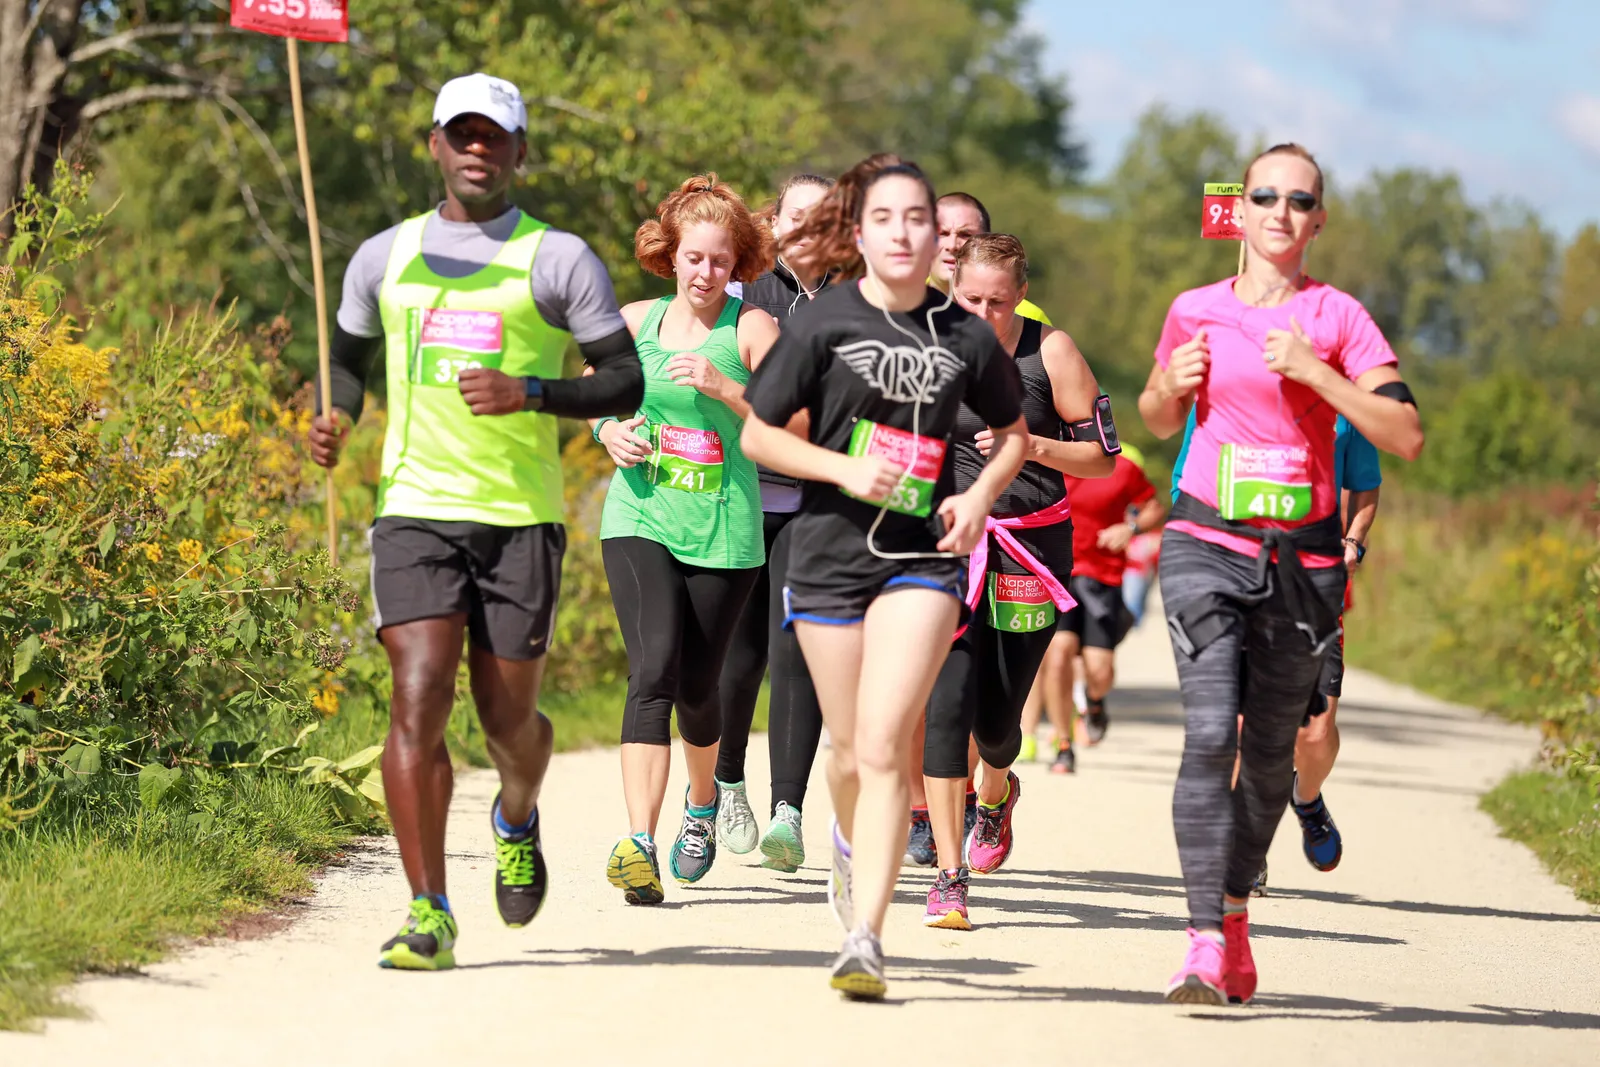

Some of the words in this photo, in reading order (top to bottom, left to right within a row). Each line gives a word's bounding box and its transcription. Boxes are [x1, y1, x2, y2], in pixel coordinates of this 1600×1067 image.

[663, 427, 721, 445] Naperville
[662, 438, 686, 452] Trails
[686, 447, 720, 456] Marathon
[1236, 445, 1308, 462] Naperville
[670, 467, 705, 490] 741
[1248, 493, 1296, 517] 419
[998, 586, 1024, 597] Trails
[999, 577, 1043, 592] Naperv
[1009, 610, 1046, 630] 618
